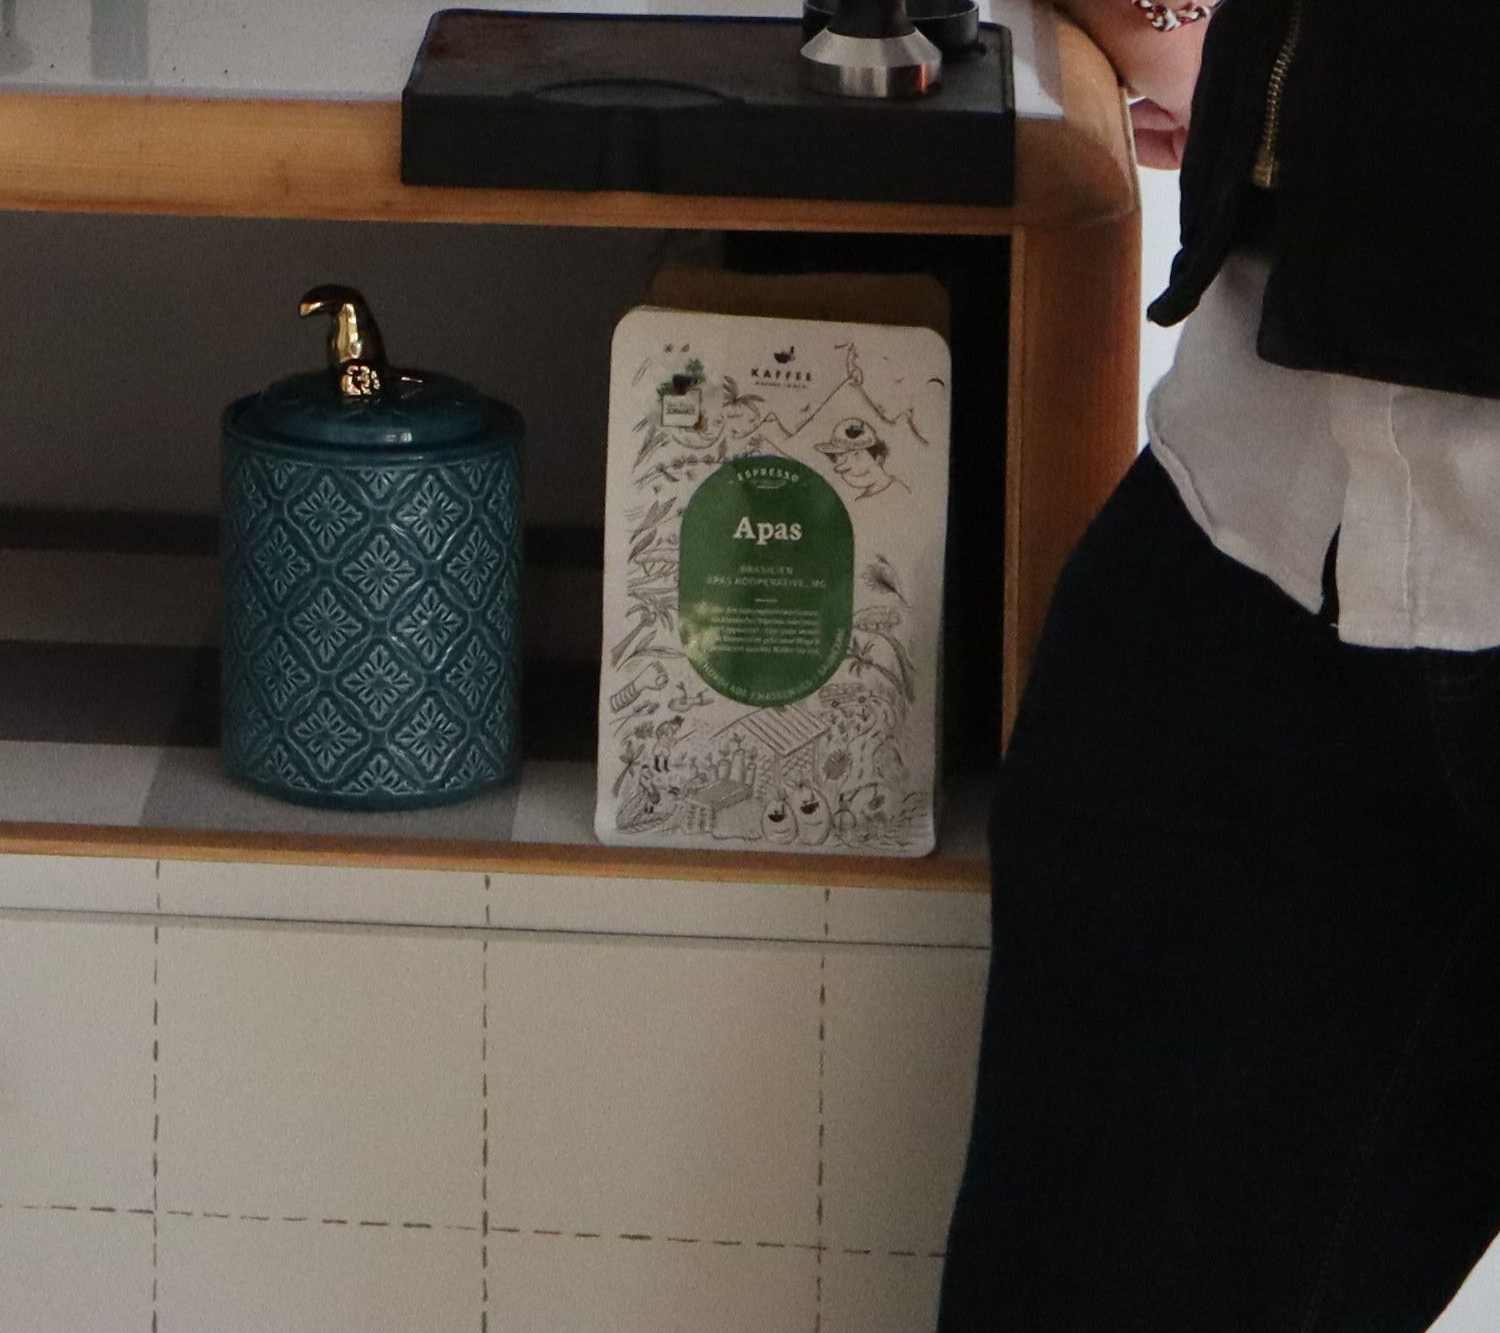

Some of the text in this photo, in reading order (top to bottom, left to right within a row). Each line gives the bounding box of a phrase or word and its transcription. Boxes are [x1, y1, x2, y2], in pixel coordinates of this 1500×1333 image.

[751, 368, 812, 382] KAFFEE
[736, 468, 799, 483] ESPRESSO
[733, 515, 803, 546] Apas
